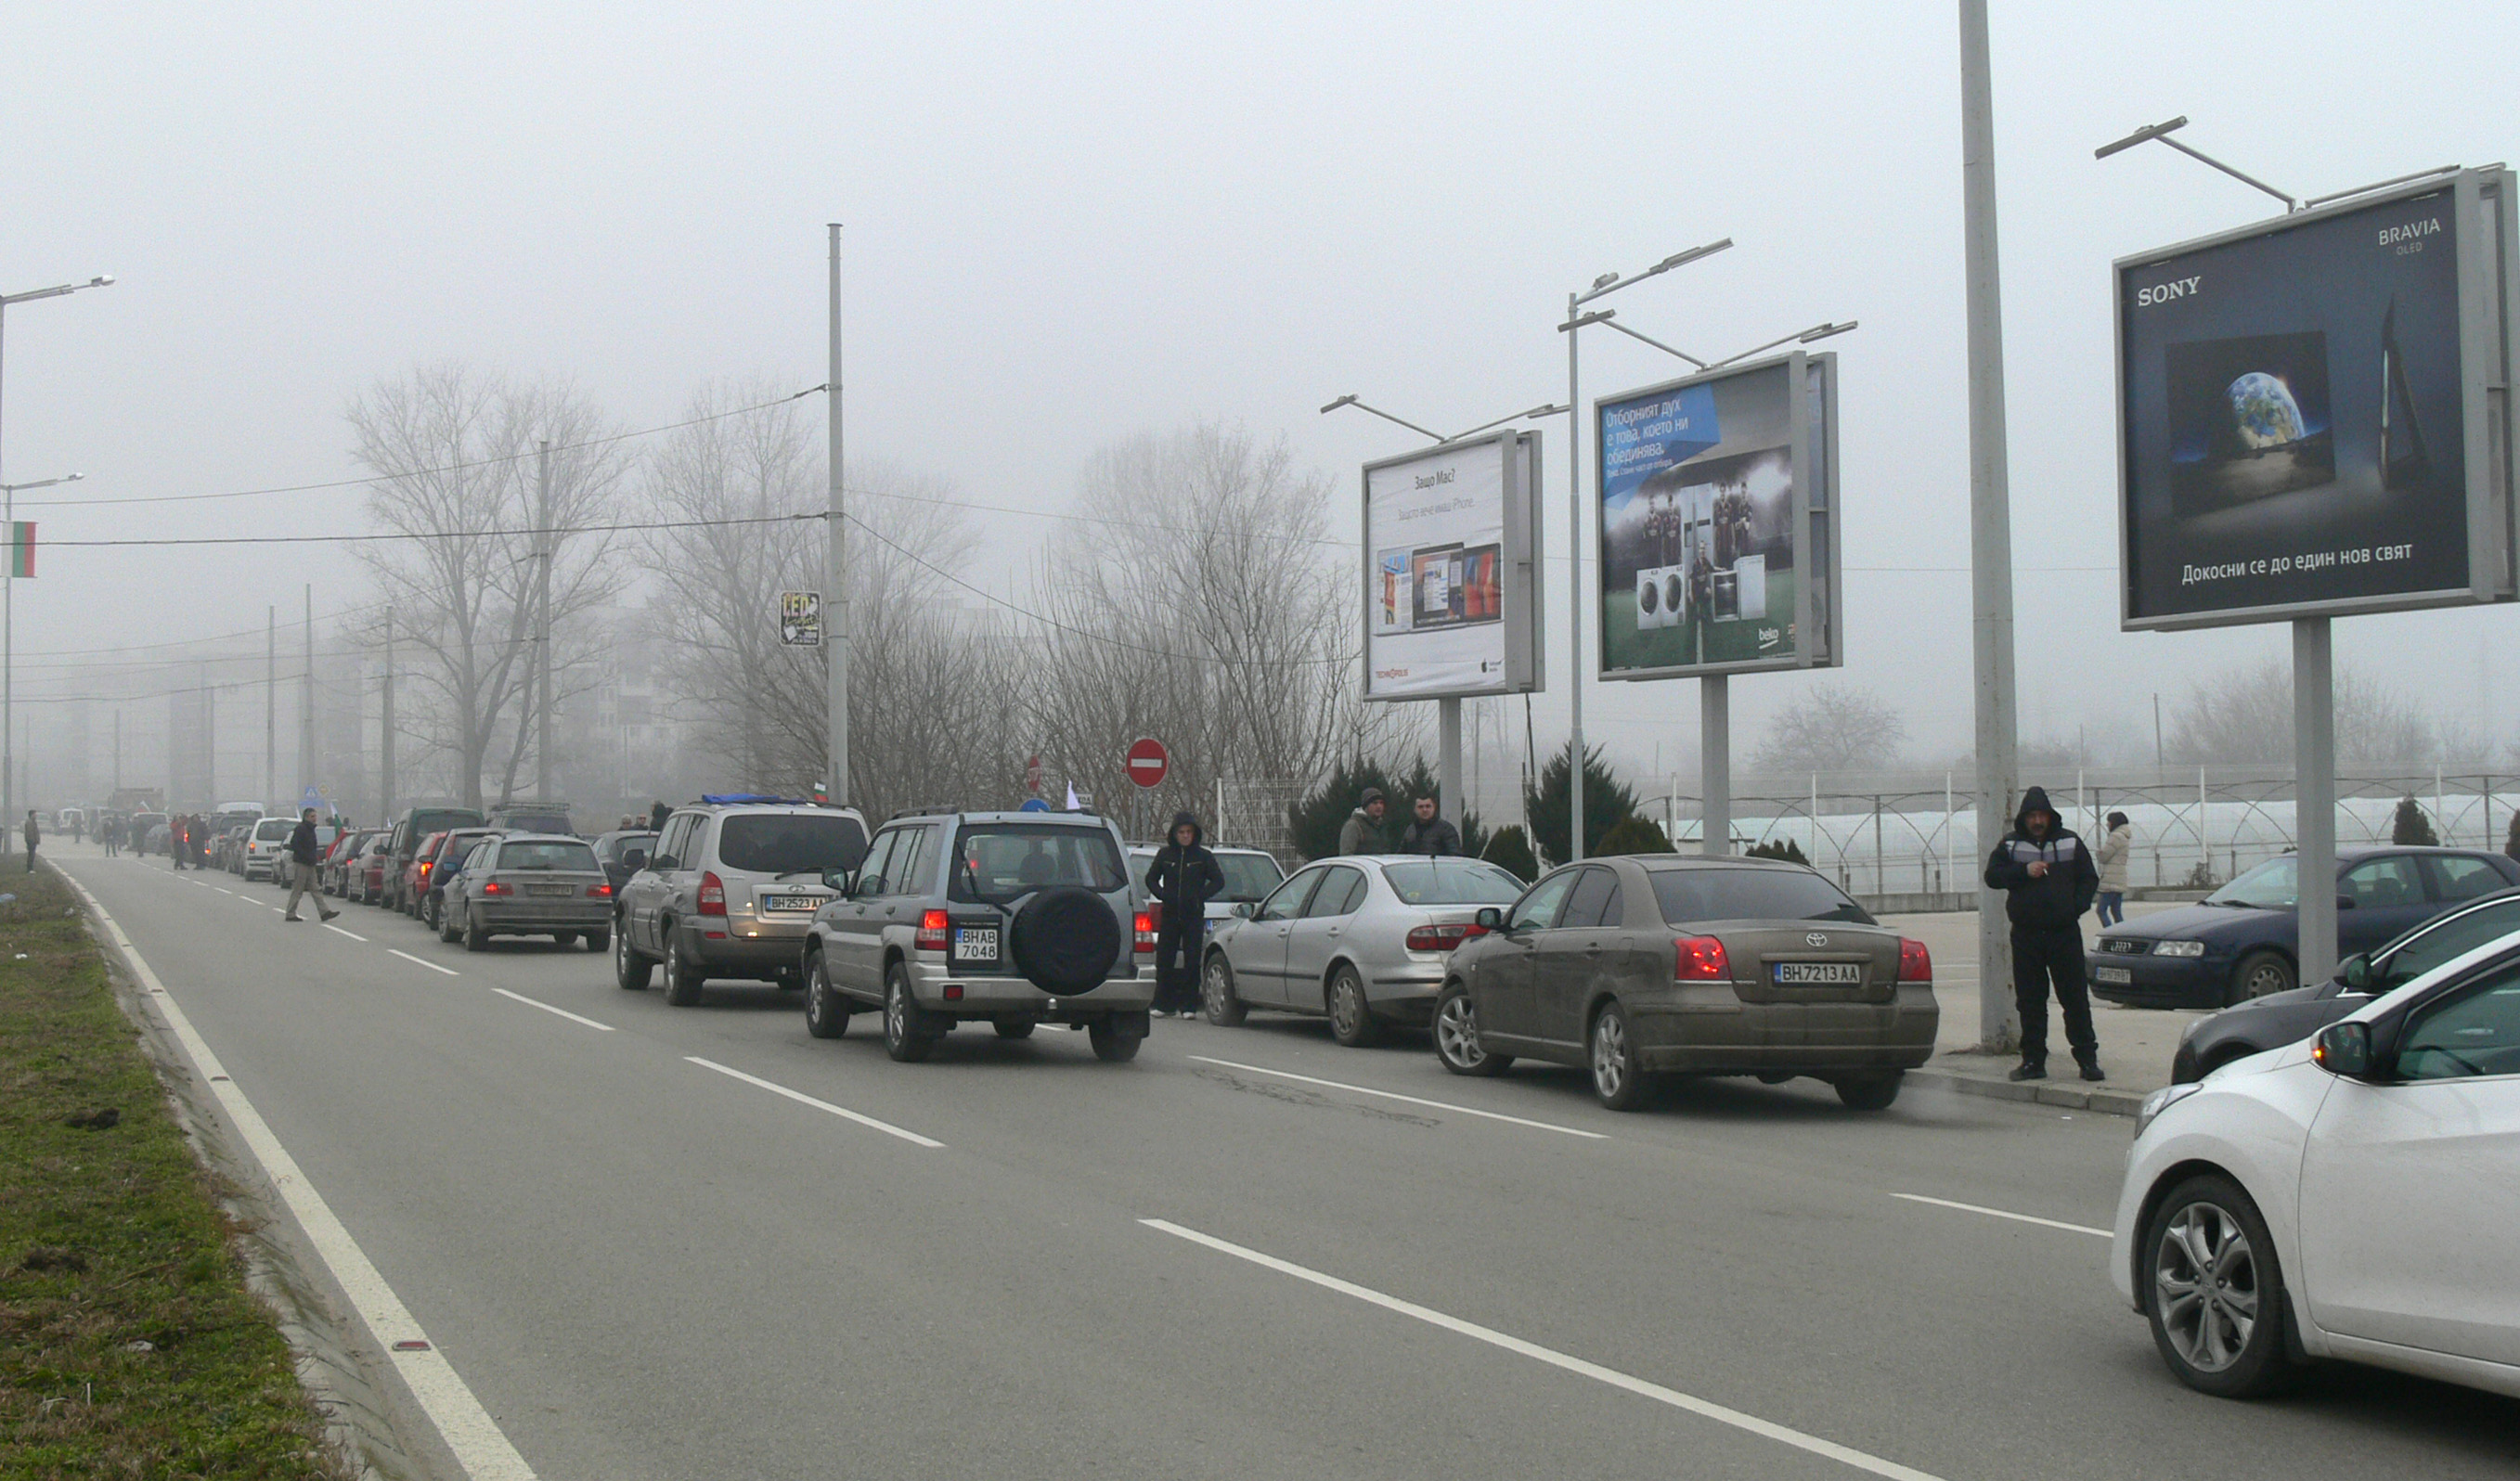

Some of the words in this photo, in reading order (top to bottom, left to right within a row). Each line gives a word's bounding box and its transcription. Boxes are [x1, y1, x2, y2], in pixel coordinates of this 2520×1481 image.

[2379, 218, 2440, 246] BRAVIA
[2397, 241, 2423, 255] OLED
[2138, 276, 2201, 307] SONY
[1606, 404, 1660, 428] Отборният
[1661, 399, 1682, 418] дух
[1607, 434, 1614, 446] е
[1616, 428, 1641, 444] това,
[1643, 420, 1673, 439] което
[1675, 417, 1688, 431] ни
[1607, 443, 1665, 466] обединява.
[1415, 476, 1435, 490] Защо
[1437, 468, 1455, 484] Mac?
[2182, 561, 2246, 586] Докосни
[2250, 560, 2267, 573] се
[2270, 557, 2290, 574] до
[2295, 553, 2335, 572] един
[2341, 548, 2370, 564] нов
[2376, 544, 2412, 560] свят
[1758, 627, 1779, 641] beko
[771, 898, 785, 908] BH
[786, 898, 810, 908] 2523
[963, 931, 996, 944] BHAB
[963, 945, 996, 958] 7048
[1803, 966, 1838, 981] 7213
[1841, 967, 1859, 981] AA
